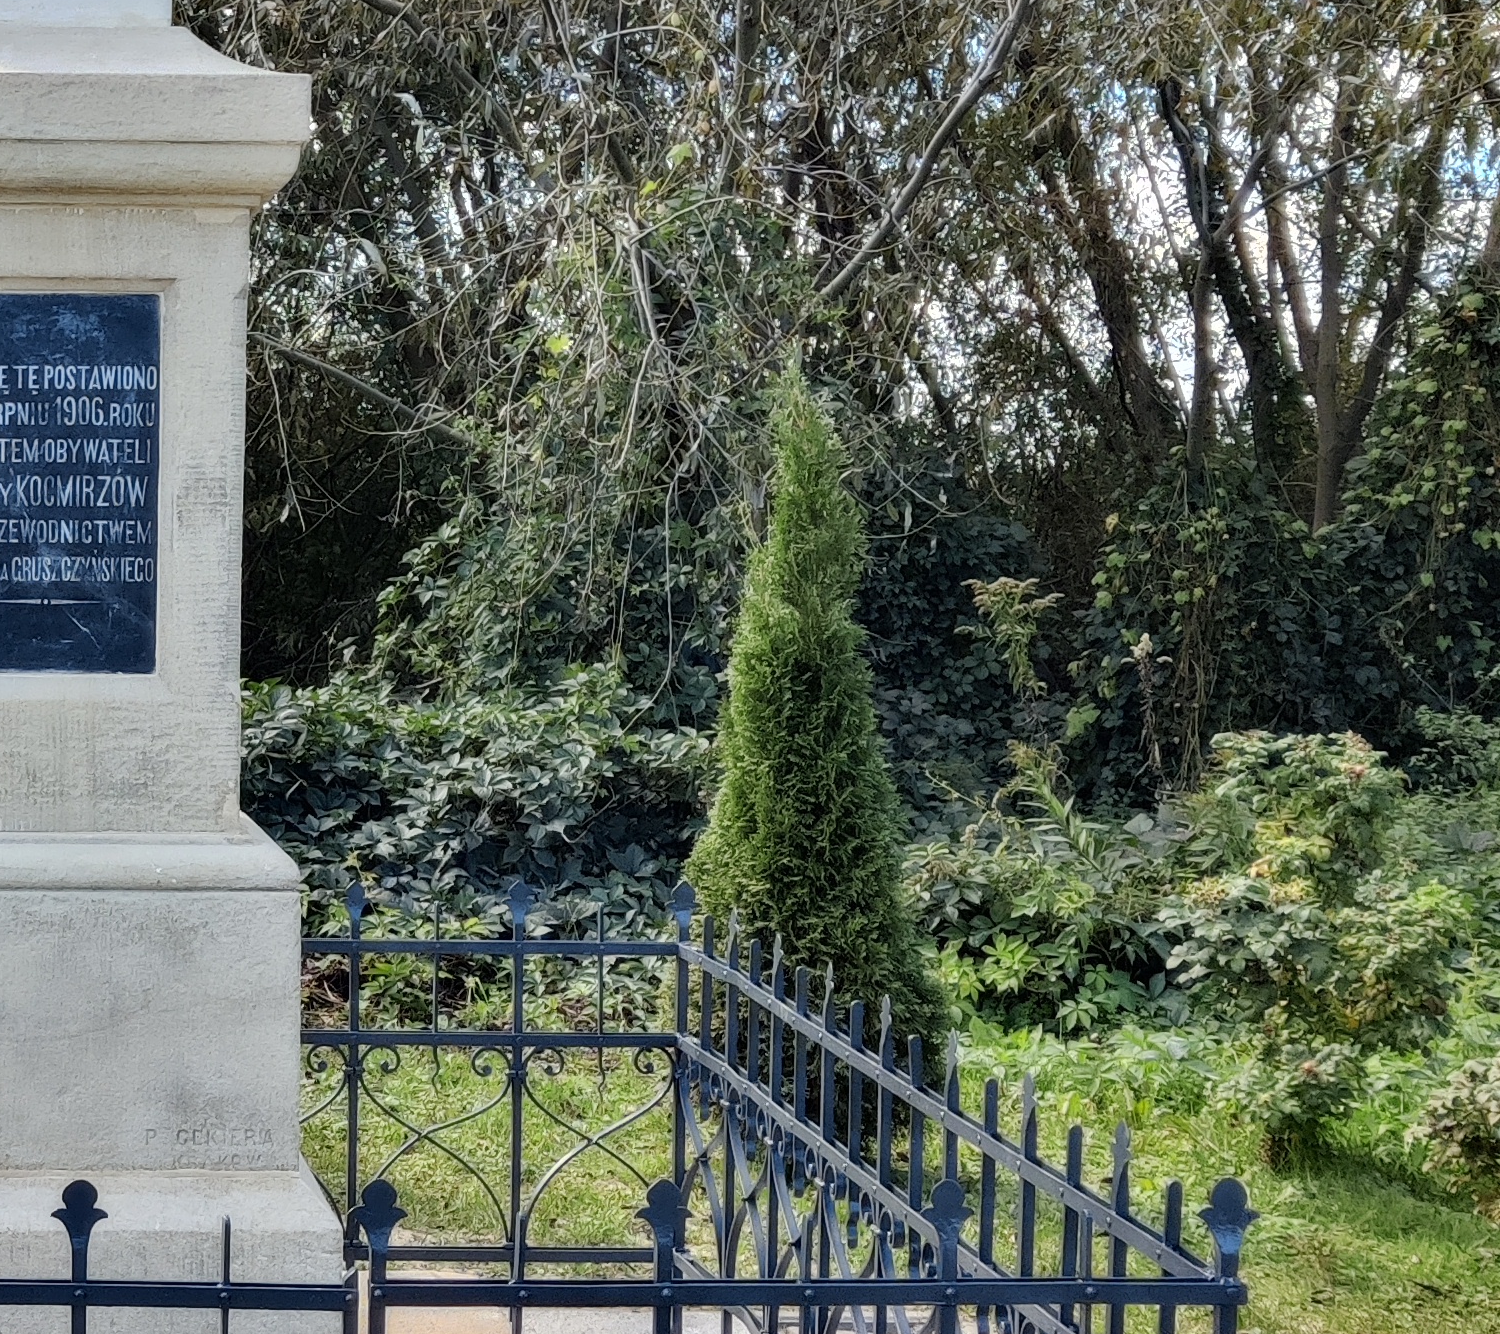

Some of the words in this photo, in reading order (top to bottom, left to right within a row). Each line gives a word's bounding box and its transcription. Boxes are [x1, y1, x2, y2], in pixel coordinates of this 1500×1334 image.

[13, 366, 40, 395] TĘ
[43, 365, 158, 390] POSTAWIONO
[44, 439, 152, 464] OBYWATELI
